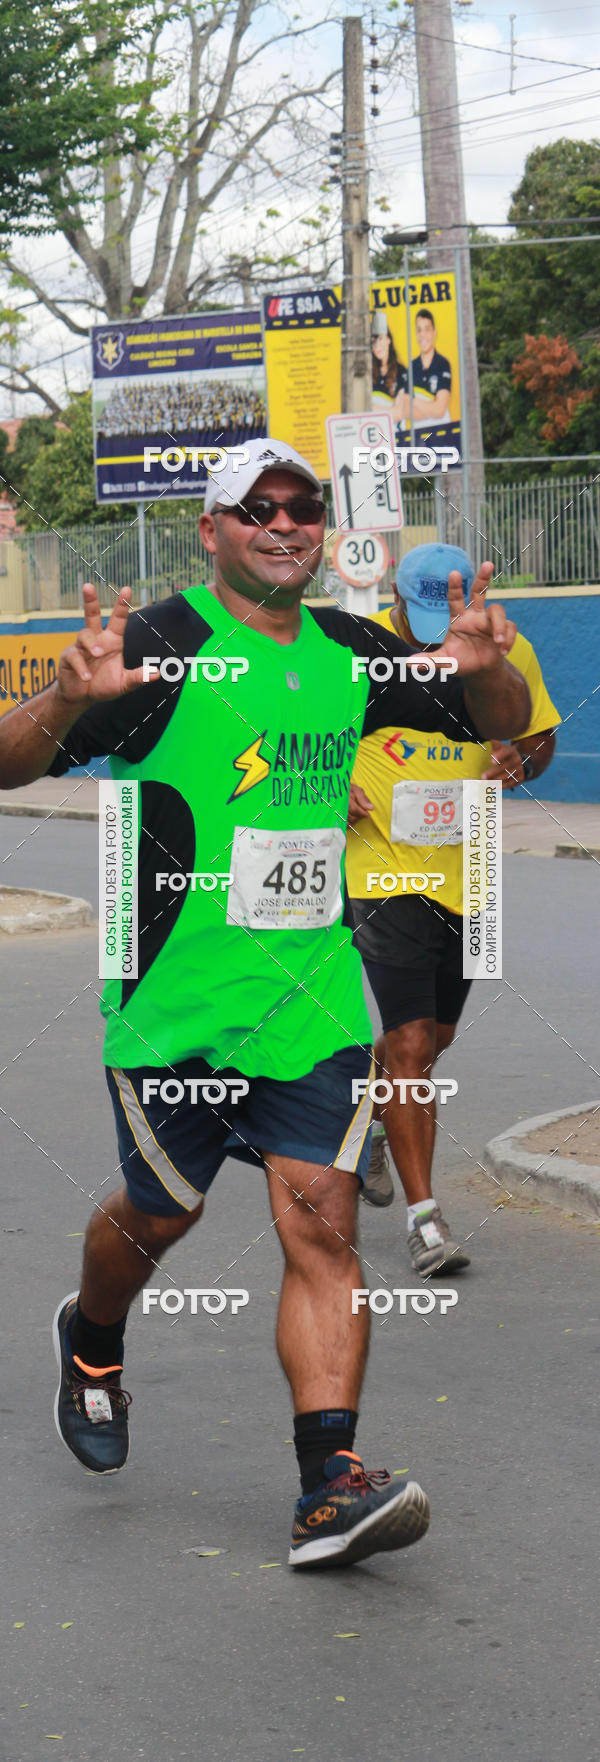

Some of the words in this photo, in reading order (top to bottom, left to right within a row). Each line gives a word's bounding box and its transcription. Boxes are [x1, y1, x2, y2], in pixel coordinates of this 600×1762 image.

[297, 295, 323, 314] SSA
[372, 281, 451, 309] LUGAR
[367, 427, 378, 443] E
[346, 539, 376, 566] 30
[273, 726, 358, 773] AMIGOS
[427, 746, 464, 761] KDK
[272, 777, 294, 807] DO
[423, 800, 456, 825] 99
[262, 860, 327, 895] 485
